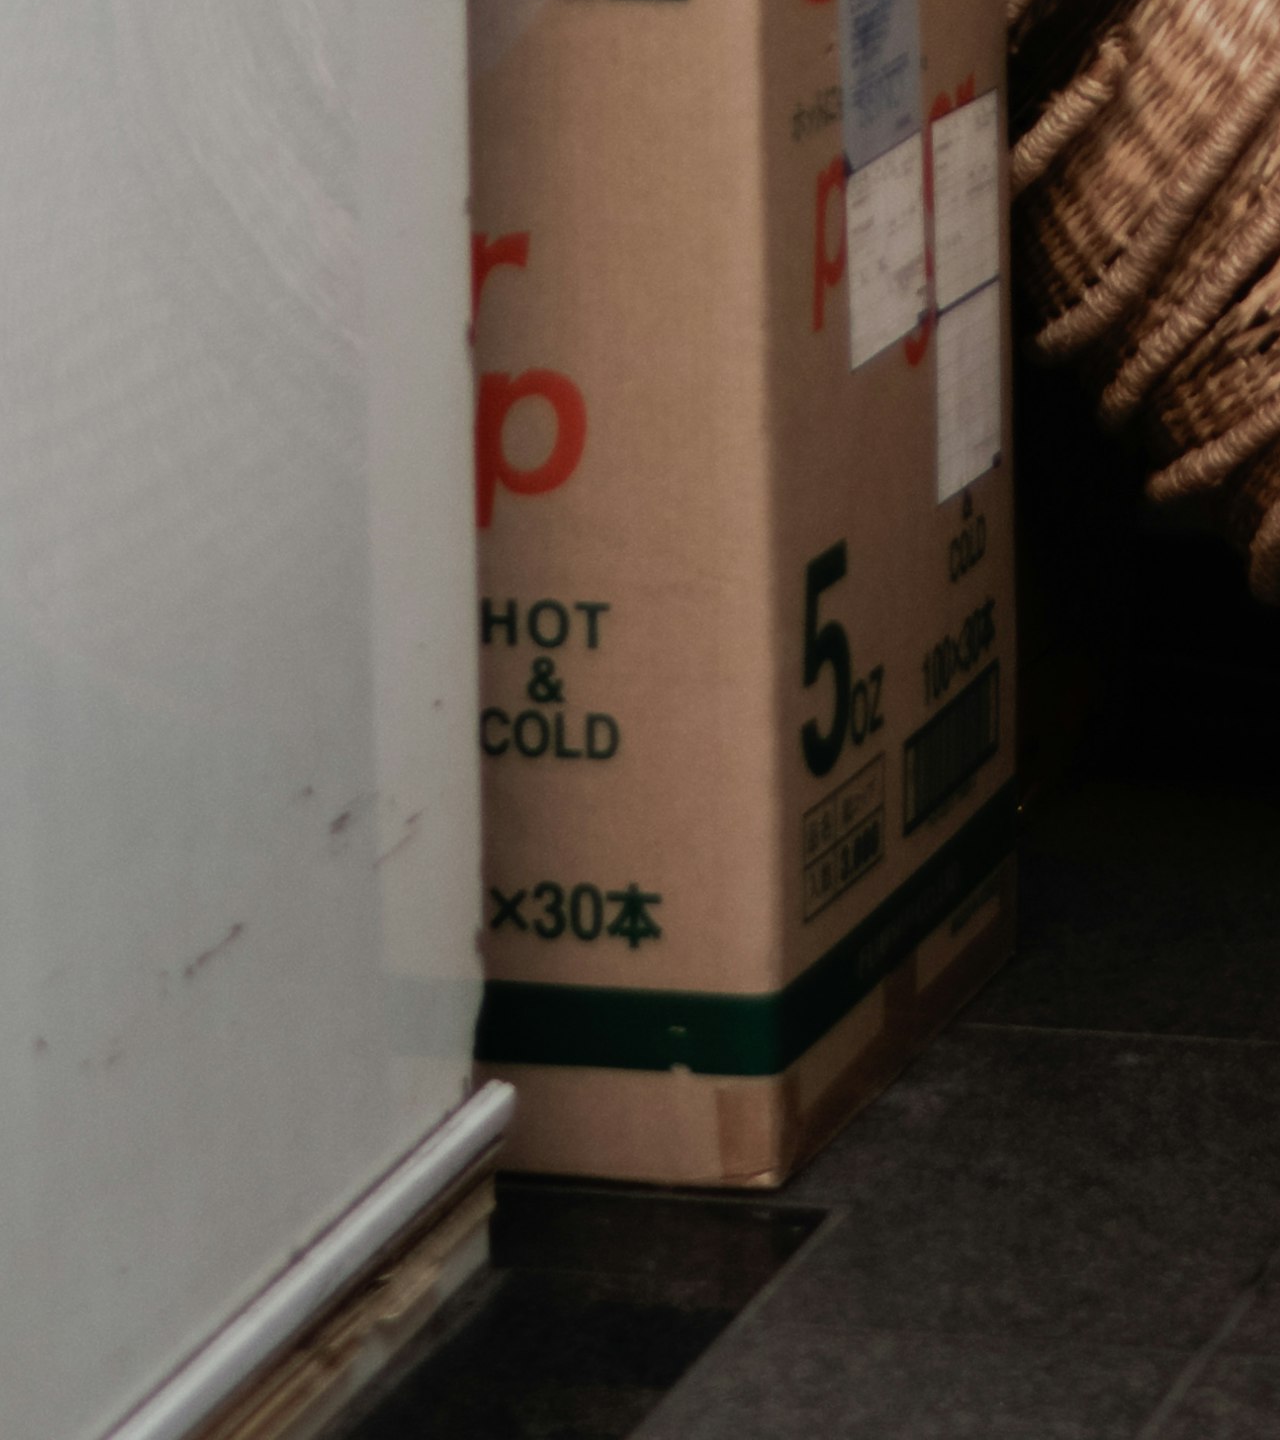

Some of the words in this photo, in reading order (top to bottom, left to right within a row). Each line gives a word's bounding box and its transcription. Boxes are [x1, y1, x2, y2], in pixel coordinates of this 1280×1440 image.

[480, 597, 611, 649] HOT
[526, 656, 565, 703] &
[480, 707, 619, 760] COLD
